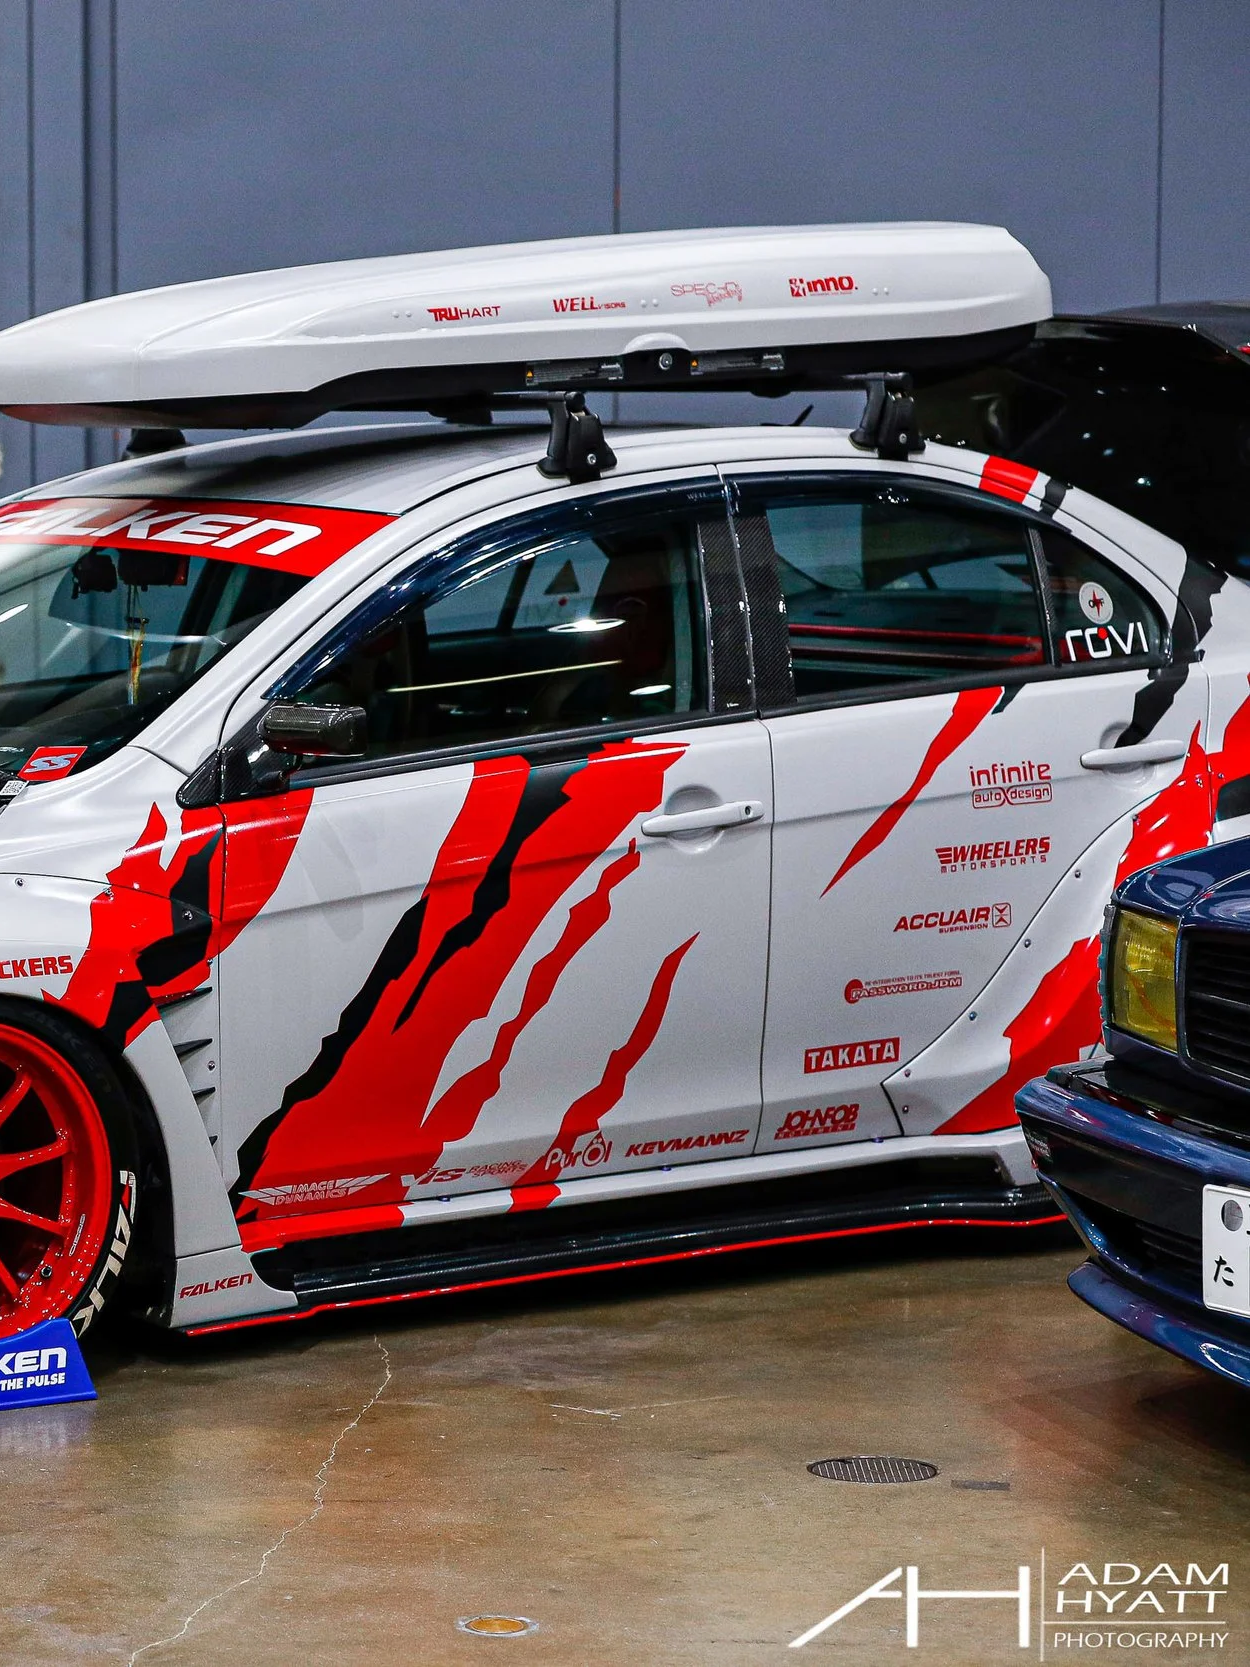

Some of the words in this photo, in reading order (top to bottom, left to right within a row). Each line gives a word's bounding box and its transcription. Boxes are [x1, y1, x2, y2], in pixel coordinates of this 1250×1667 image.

[969, 760, 1052, 786] infinite
[975, 791, 1001, 803] auto
[1011, 787, 1050, 800] design
[951, 836, 1050, 863] WHEELERS
[940, 855, 1047, 873] MOTORSPORTS
[893, 906, 991, 932] ACCUAIR
[939, 923, 988, 934] SUSPENSION
[808, 1041, 896, 1070] TAKATA
[624, 1130, 750, 1157] KEVMANNZ
[291, 1180, 336, 1194] IMAGE
[1213, 1255, 1235, 1287] た
[178, 1273, 253, 1299] FALKEN
[0, 1378, 23, 1391] THE
[27, 1373, 66, 1388] PULSE
